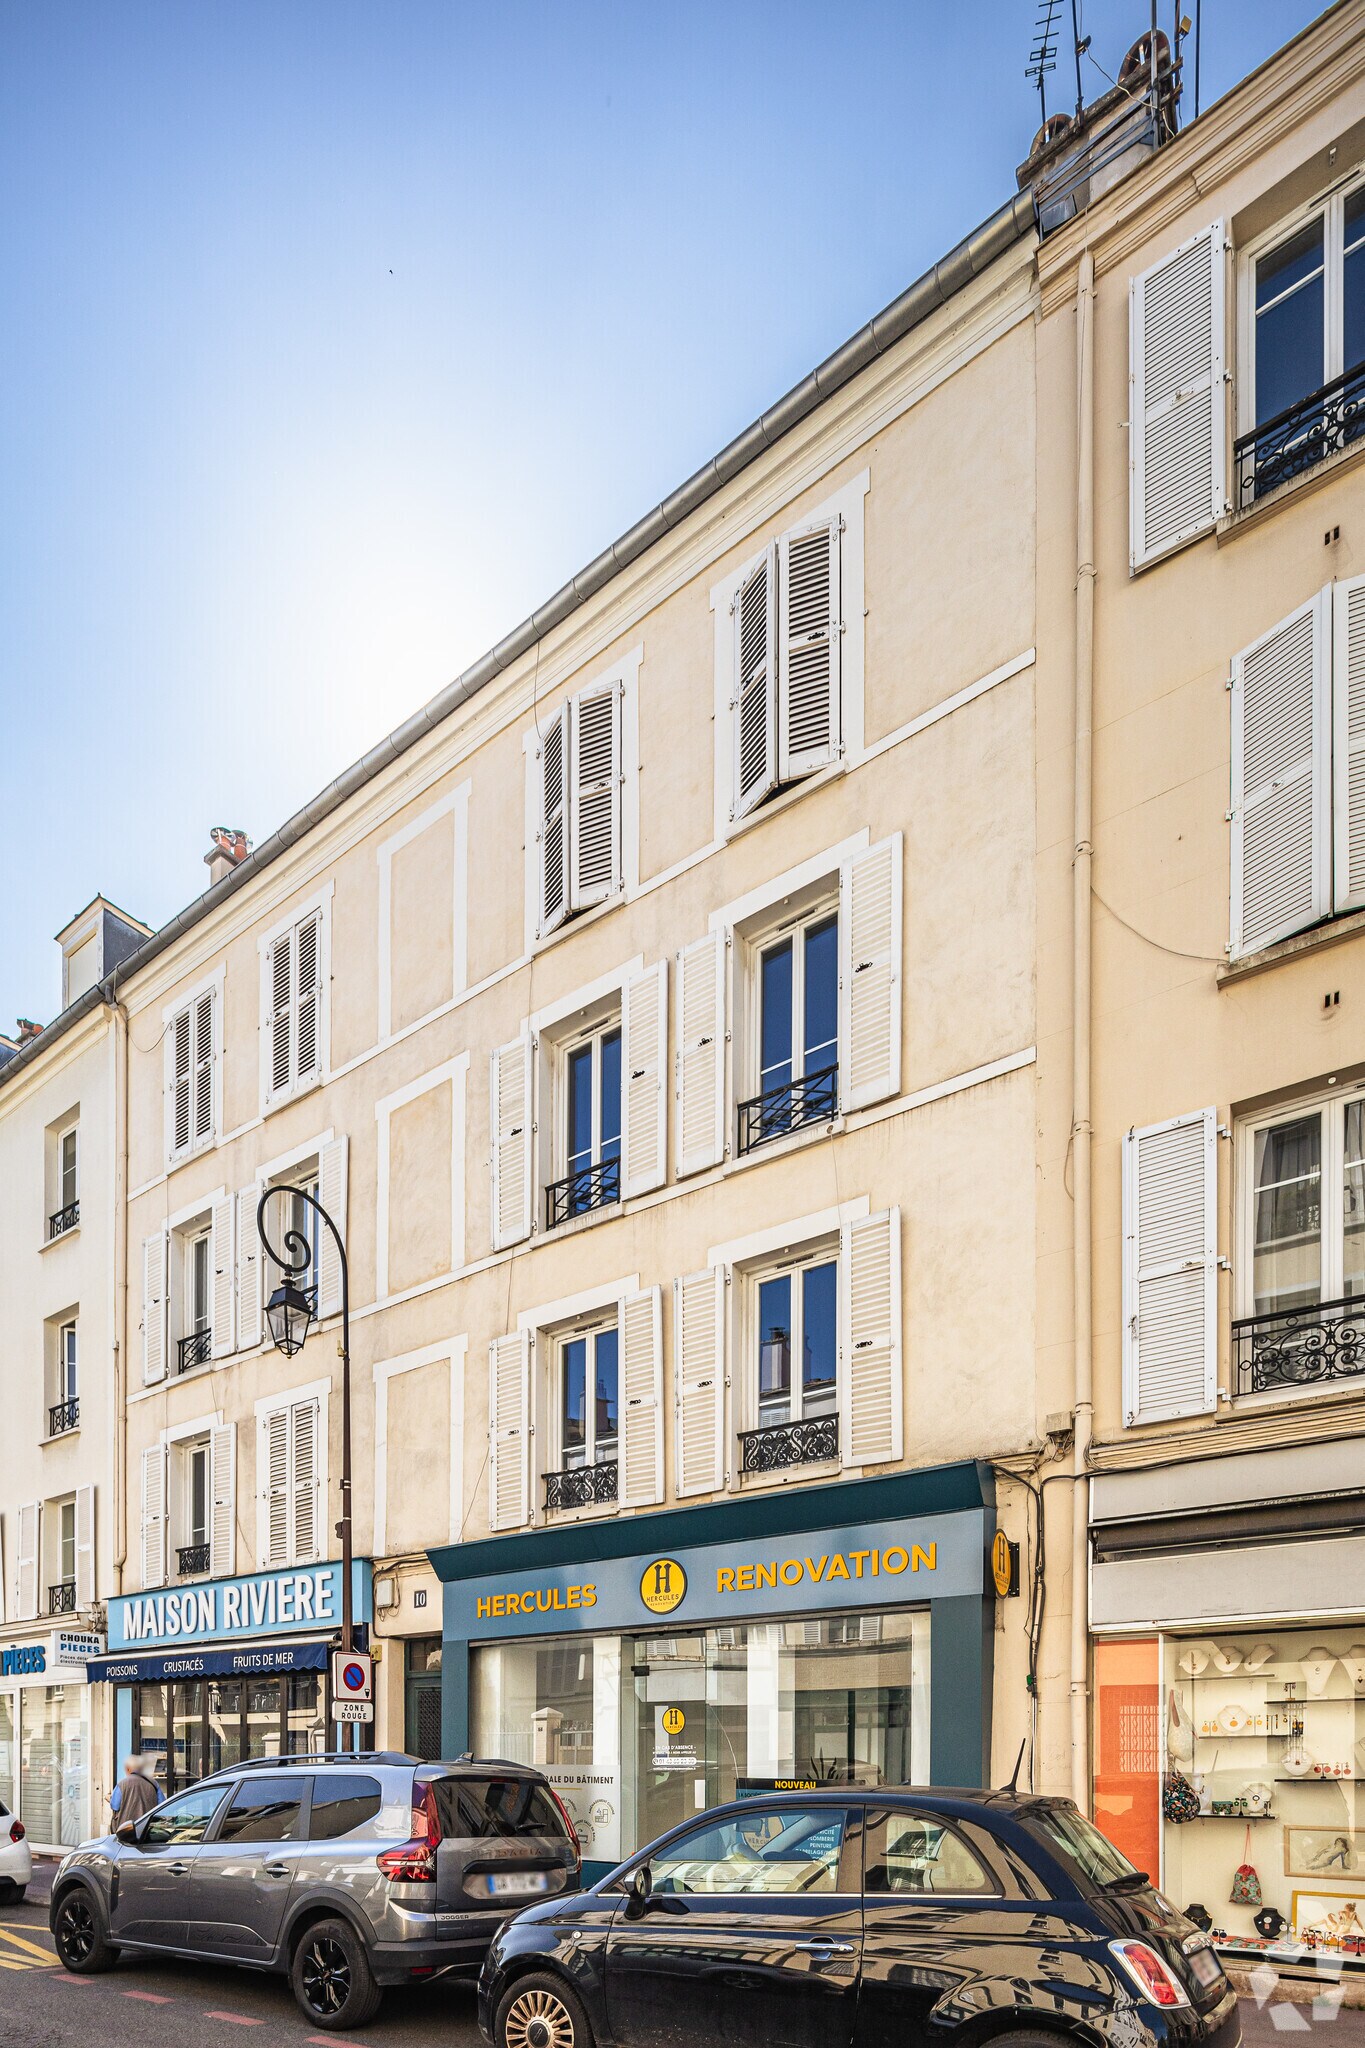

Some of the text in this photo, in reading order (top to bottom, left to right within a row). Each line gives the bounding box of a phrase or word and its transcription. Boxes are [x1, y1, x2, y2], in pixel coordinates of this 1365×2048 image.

[716, 1542, 937, 1593] RENOVATION
[415, 1592, 426, 1607] 10
[476, 1583, 598, 1619] HERCULES
[646, 1593, 680, 1602] HERCULES
[123, 1570, 333, 1641] MAISON RIVIERE
[60, 1633, 100, 1644] CHOUKA
[106, 1652, 294, 1677] POISSONS CRUSTACÉS FRUITS DE MER
[344, 1704, 365, 1712] ZONE
[341, 1712, 367, 1720] ROUGE
[563, 1776, 574, 1784] DU
[576, 1774, 614, 1784] BÂTIMENT
[774, 1780, 817, 1790] NOUVEAU
